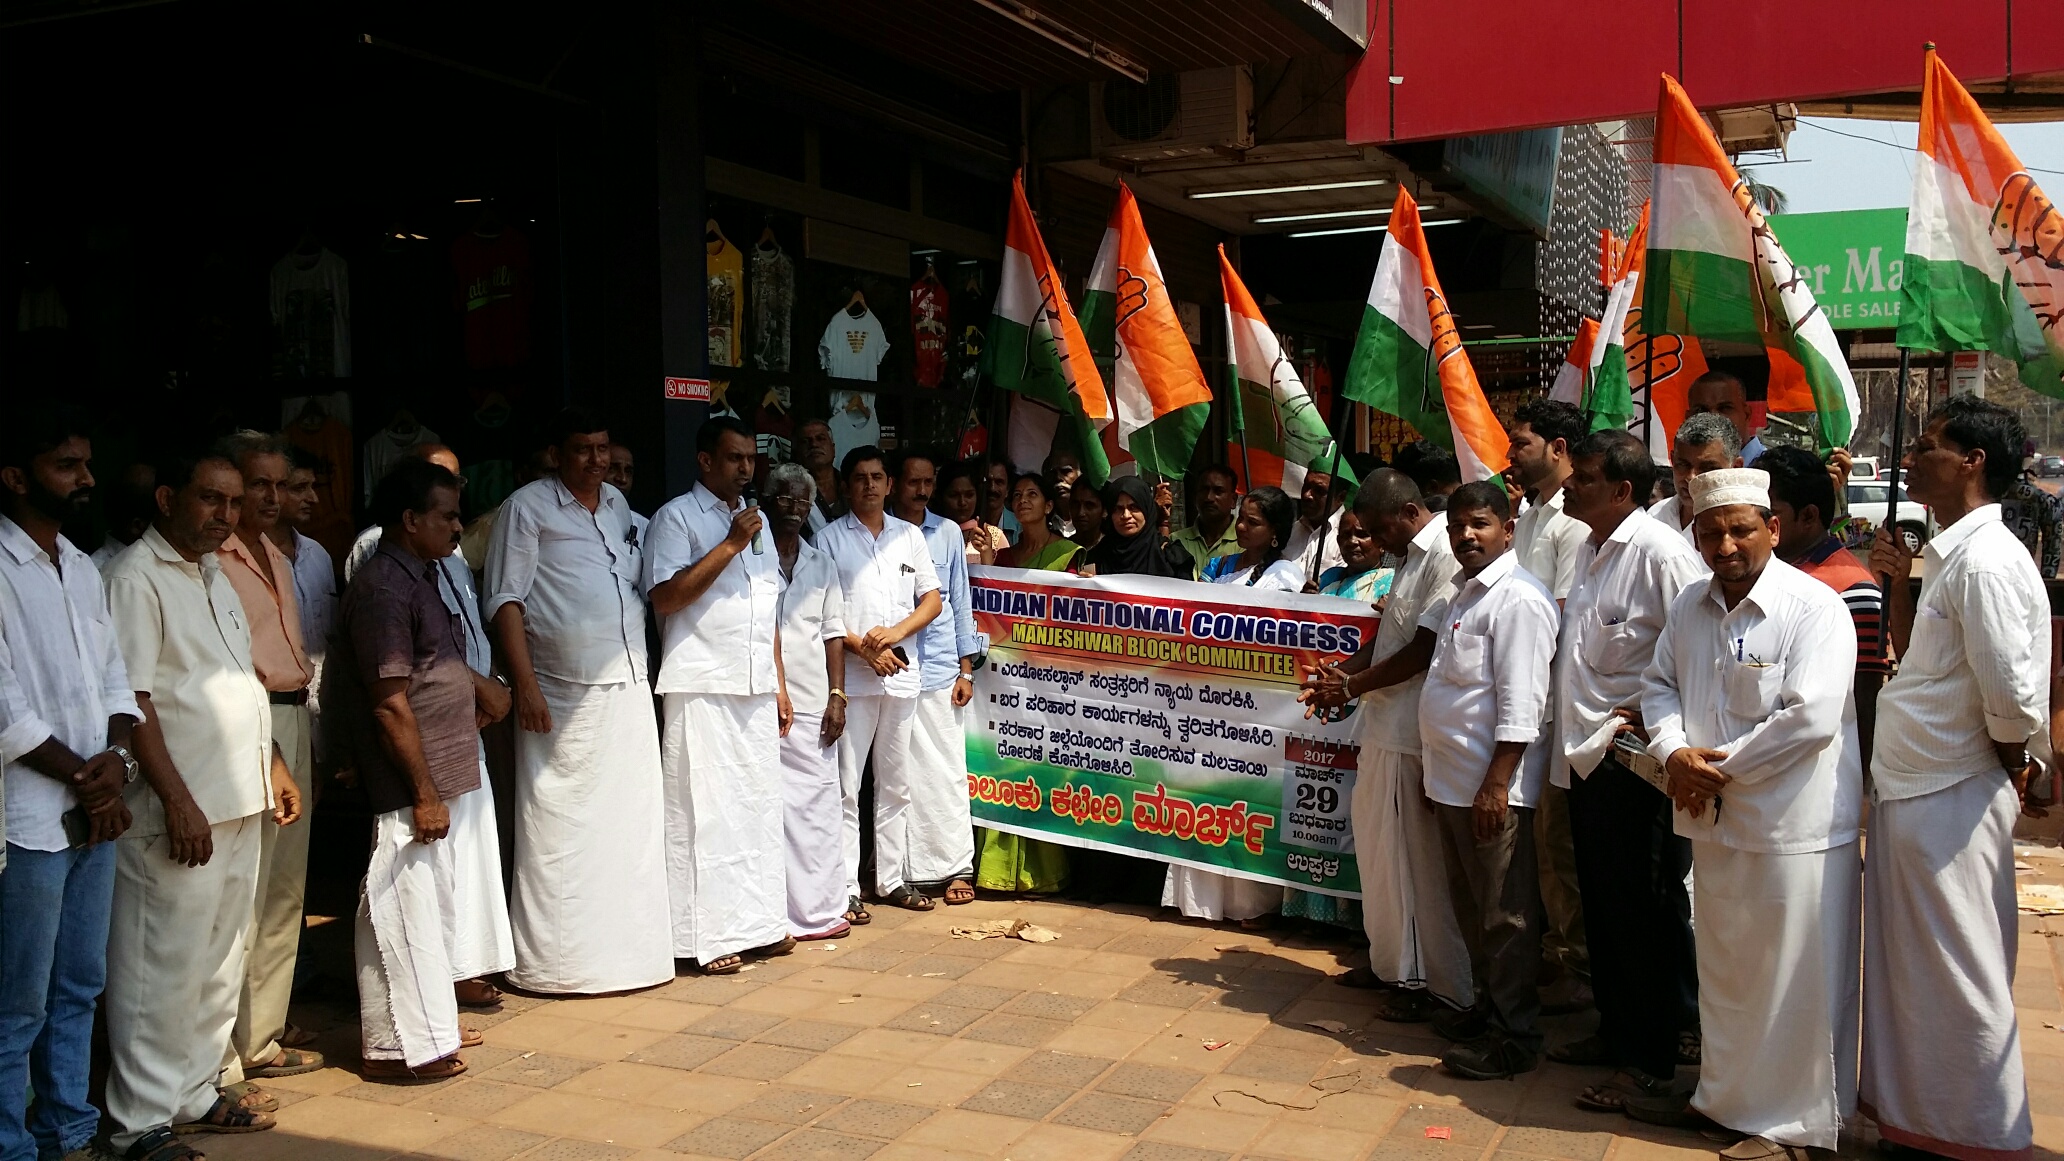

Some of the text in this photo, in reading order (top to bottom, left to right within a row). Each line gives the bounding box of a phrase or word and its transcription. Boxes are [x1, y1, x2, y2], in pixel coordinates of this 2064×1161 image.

[1796, 247, 1903, 295] er Ma
[1819, 303, 1852, 318] OLE
[678, 383, 709, 397] NO SMOKING
[970, 587, 1361, 654] NDIAN NATIONAL CONGRESS
[1012, 623, 1294, 676] MANJESHWAR BLOCK COMMITTEE
[1001, 661, 1258, 711] ಎಂಡೋಸಲ್ಫಾನ್ ಸಂತ್ರಸ್ತರಿಗೆ ನ್ಯಾಯ ದೊರಕಿಸಿ.
[1000, 692, 1020, 708] ಬರ
[1026, 694, 1076, 716] ಪರಿಹಾರ
[1082, 704, 1171, 740] ಕಾರ್ಯಗಳನ್ನು
[998, 720, 1268, 777] ಸರಕಾರ ಜಿಲ್ಲೆಯೊಂದಿಗೆ ತೋರಿಸುವ ಮಲತಾಯಿ
[998, 740, 1043, 761] ಧೋರಣೆ
[1304, 750, 1336, 765] 2017
[1295, 764, 1345, 784] ಮಾರ್ಚ್
[1295, 783, 1339, 813] 29
[1132, 781, 1274, 855] ಮಾರ್ಚ್
[1289, 812, 1346, 832] ಬುಧವಾರ
[1292, 830, 1338, 846] 10.00am
[1287, 852, 1340, 883] ಉಪ್ಪಳ
